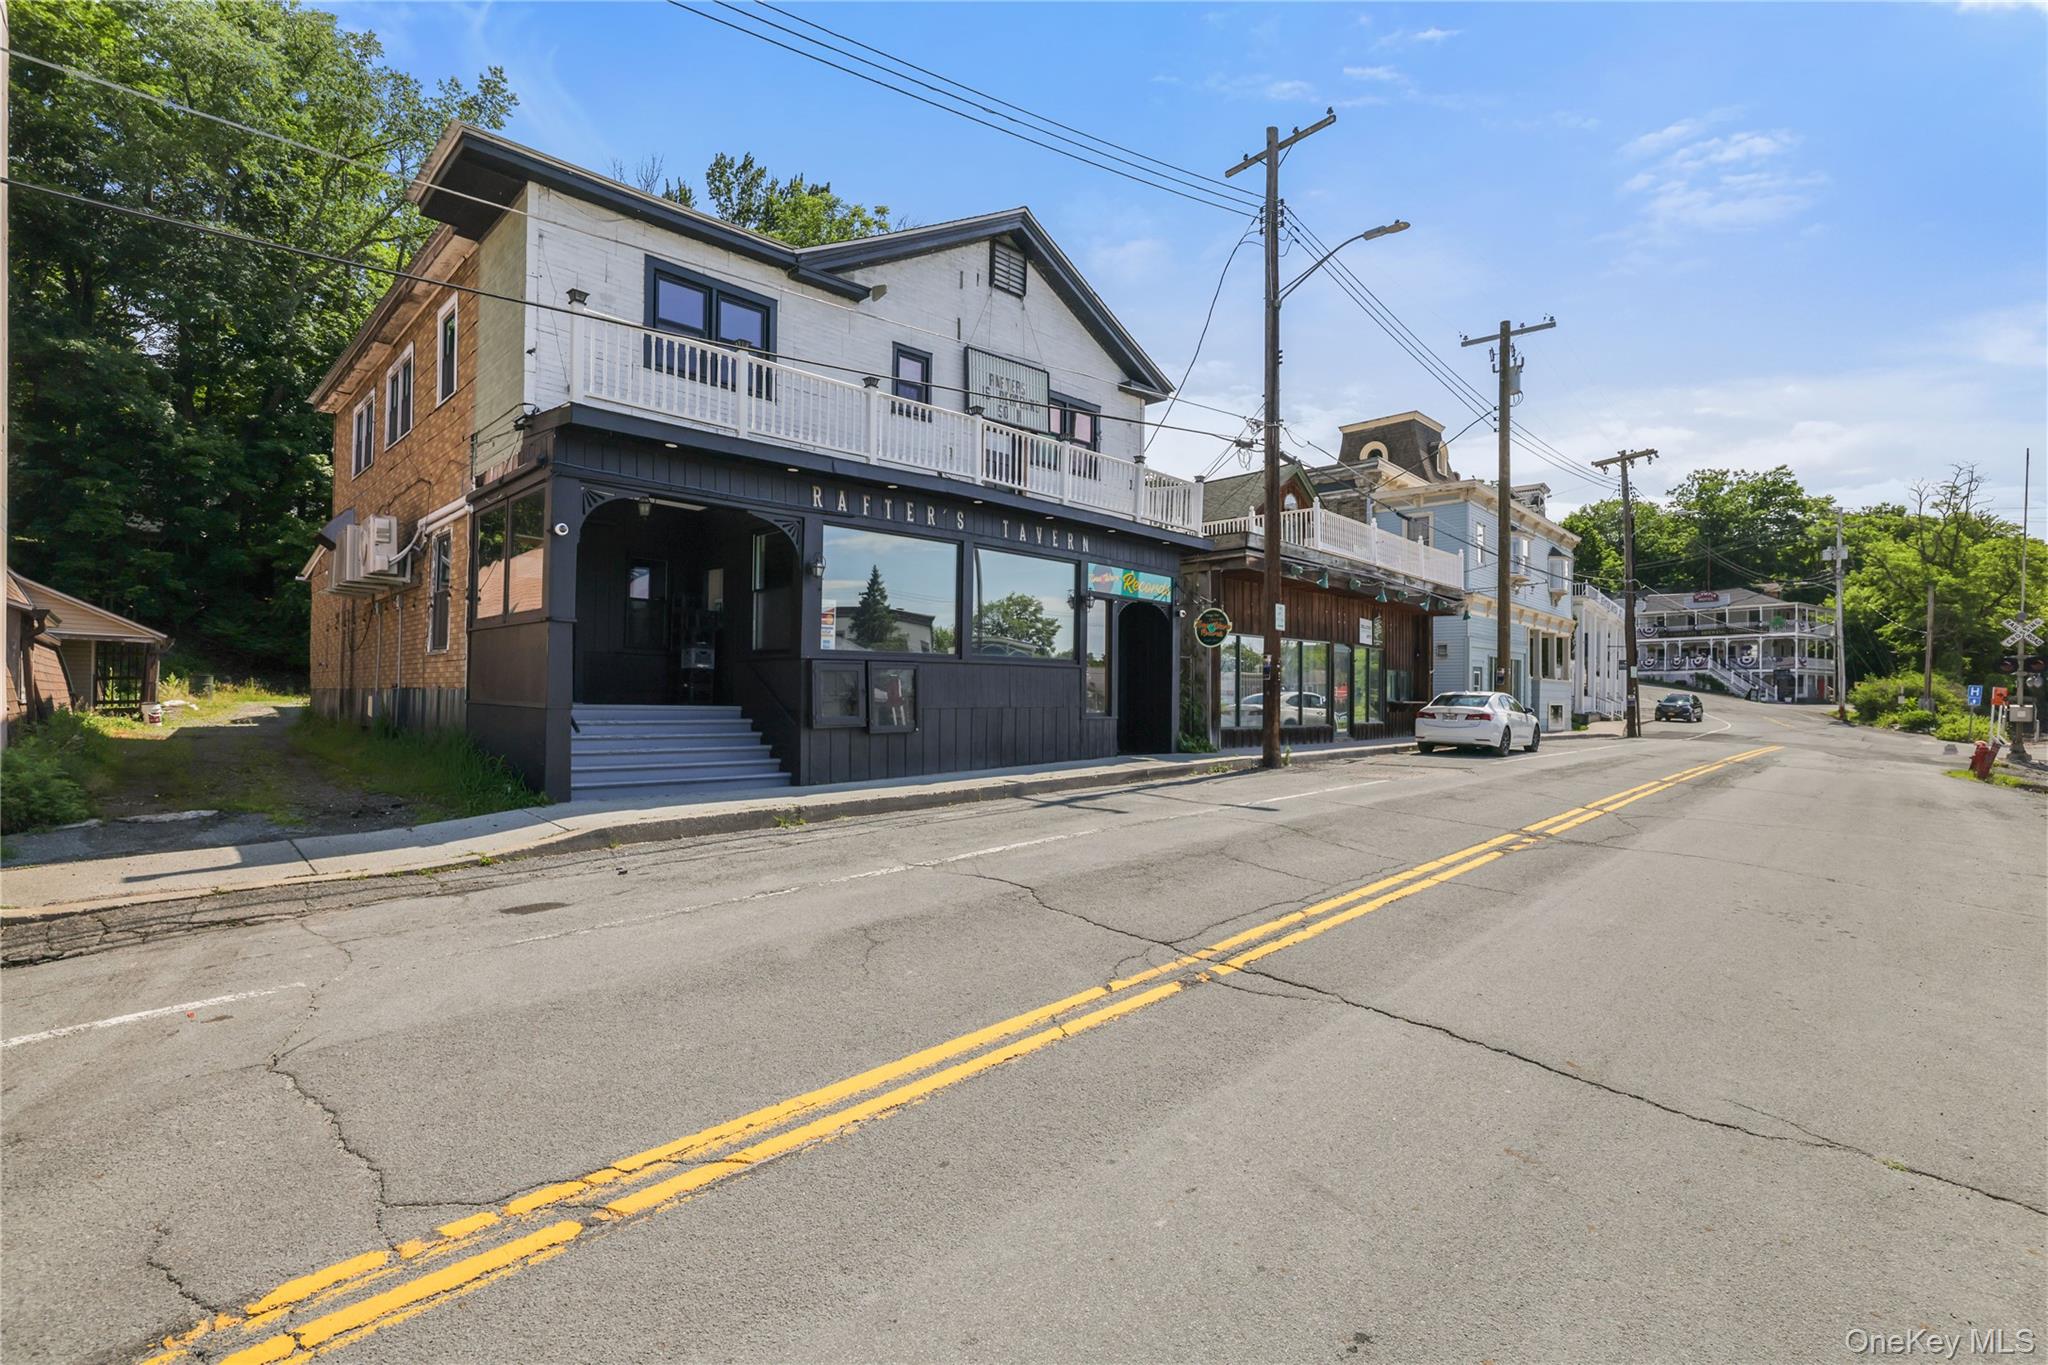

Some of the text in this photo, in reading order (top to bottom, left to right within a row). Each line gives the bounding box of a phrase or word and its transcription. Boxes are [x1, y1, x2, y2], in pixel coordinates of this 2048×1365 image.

[812, 485, 1089, 552] RAFTER'S TAVERN
[1970, 687, 1980, 696] H
